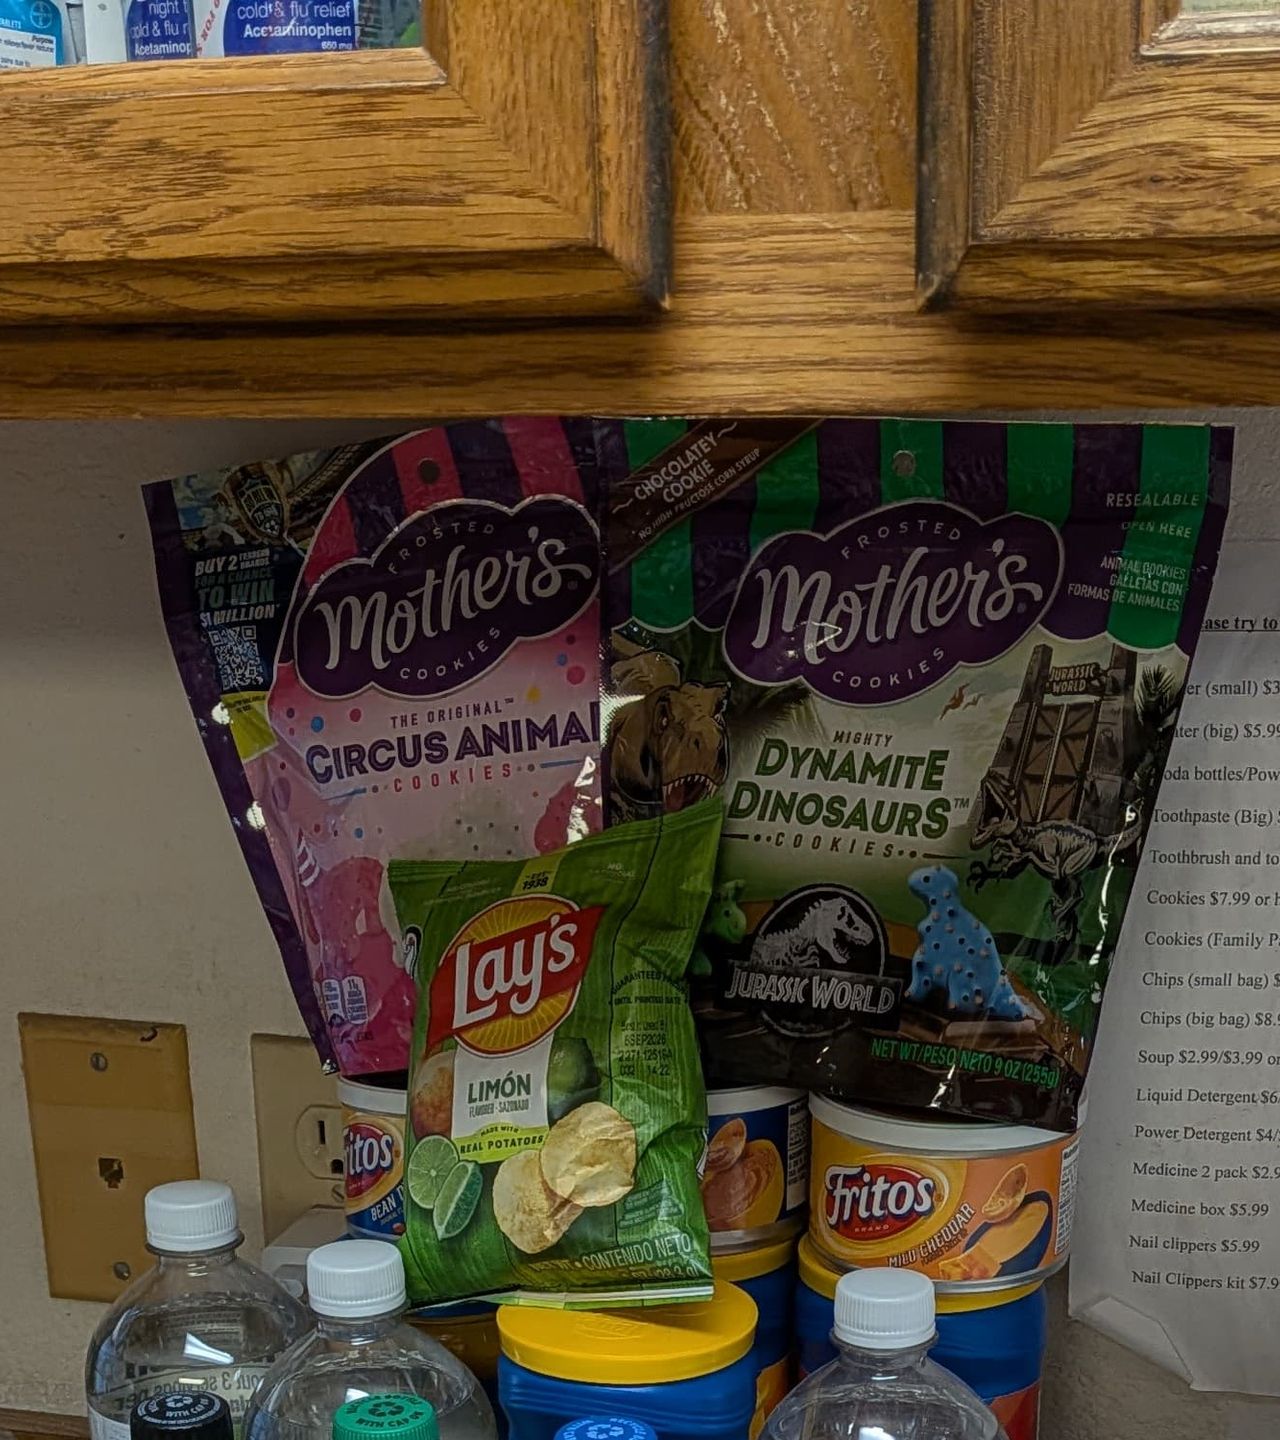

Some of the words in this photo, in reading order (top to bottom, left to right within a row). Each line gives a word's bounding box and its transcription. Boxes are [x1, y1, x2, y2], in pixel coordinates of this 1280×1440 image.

[237, 2, 269, 20] cold
[273, 2, 285, 18] &
[290, 0, 309, 17] flu
[313, 2, 351, 17] relief
[243, 22, 352, 39] Acetaminophen
[634, 431, 719, 500] CHOCOLATEY
[662, 459, 716, 502] COOKIE
[1106, 492, 1200, 507] RESEALABLE
[841, 518, 961, 559] FROSTED
[1121, 521, 1155, 533] OPEN
[1160, 522, 1192, 538] HERE
[388, 521, 495, 575] FROSTED
[314, 524, 592, 671] Mother's
[751, 537, 1043, 665] Mother's
[1234, 616, 1256, 633] try
[1263, 616, 1278, 630] to
[399, 626, 501, 680] COOKIES
[832, 646, 945, 688] COOKIES
[390, 712, 419, 728] THE
[427, 702, 503, 724] ORIGINAL
[833, 730, 894, 747] MIGHTY
[306, 727, 450, 785] CIRCUS
[755, 738, 950, 791] DYNAMITE
[393, 763, 512, 793] COOKIES
[728, 780, 954, 839] DINOSAURS
[774, 831, 894, 859] COOKIES
[1150, 850, 1230, 867] Toothbrush
[1234, 850, 1261, 866] and
[521, 875, 550, 891] 1938
[1147, 890, 1206, 907] Cookies
[1209, 890, 1251, 908] $7.99
[1254, 895, 1271, 906] or
[1144, 931, 1203, 948] Cookies
[1207, 931, 1264, 951] (Family
[453, 913, 581, 1031] Lay's
[724, 970, 807, 1005] JURASSIC
[810, 974, 897, 1015] WORLD
[871, 1037, 899, 1061] NET
[959, 1048, 992, 1073] NETO
[993, 1052, 1004, 1074] 9
[1004, 1055, 1021, 1077] OZ
[1021, 1059, 1061, 1090] (255g)
[467, 1069, 531, 1104] LIMÓN
[460, 1143, 483, 1154] REAL
[488, 1135, 544, 1150] POTATOES
[480, 1126, 498, 1136] MADE
[1132, 1162, 1198, 1178] Medicine
[1201, 1165, 1211, 1178] 2
[1214, 1164, 1248, 1183] pack
[370, 1194, 397, 1222] BEAN
[826, 1167, 934, 1226] Fritos
[1131, 1199, 1196, 1215] Medicine
[1200, 1200, 1225, 1216] box
[1229, 1201, 1269, 1218] $5.99
[886, 1249, 917, 1269] MILD
[919, 1202, 976, 1261] CHEDDAR
[1128, 1234, 1159, 1250] Nail
[1163, 1236, 1217, 1256] clippers
[1220, 1238, 1260, 1255] $5.99
[582, 1241, 654, 1271] CONTENIDO
[654, 1233, 692, 1259] NETO
